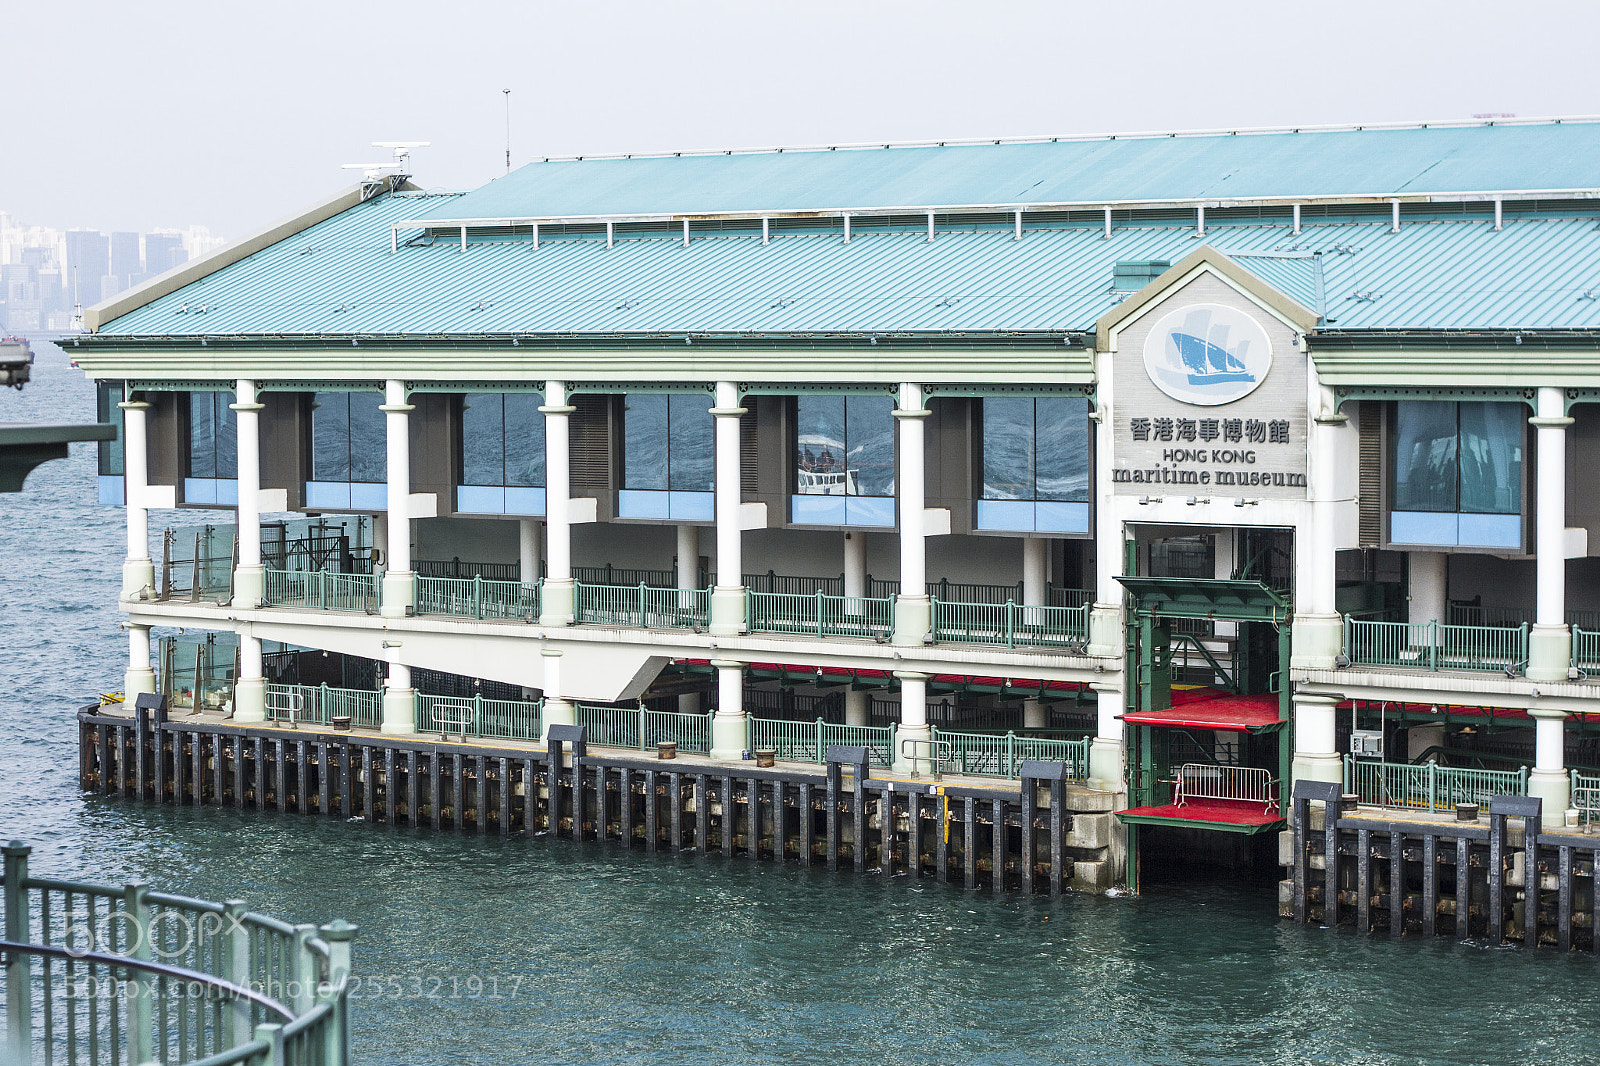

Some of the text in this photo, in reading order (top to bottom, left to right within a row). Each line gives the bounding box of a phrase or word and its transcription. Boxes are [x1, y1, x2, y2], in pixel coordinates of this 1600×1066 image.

[1130, 416, 1290, 444] 香港海事博物館
[1163, 448, 1256, 464] HONG KONG
[1112, 463, 1307, 488] maritime museum
